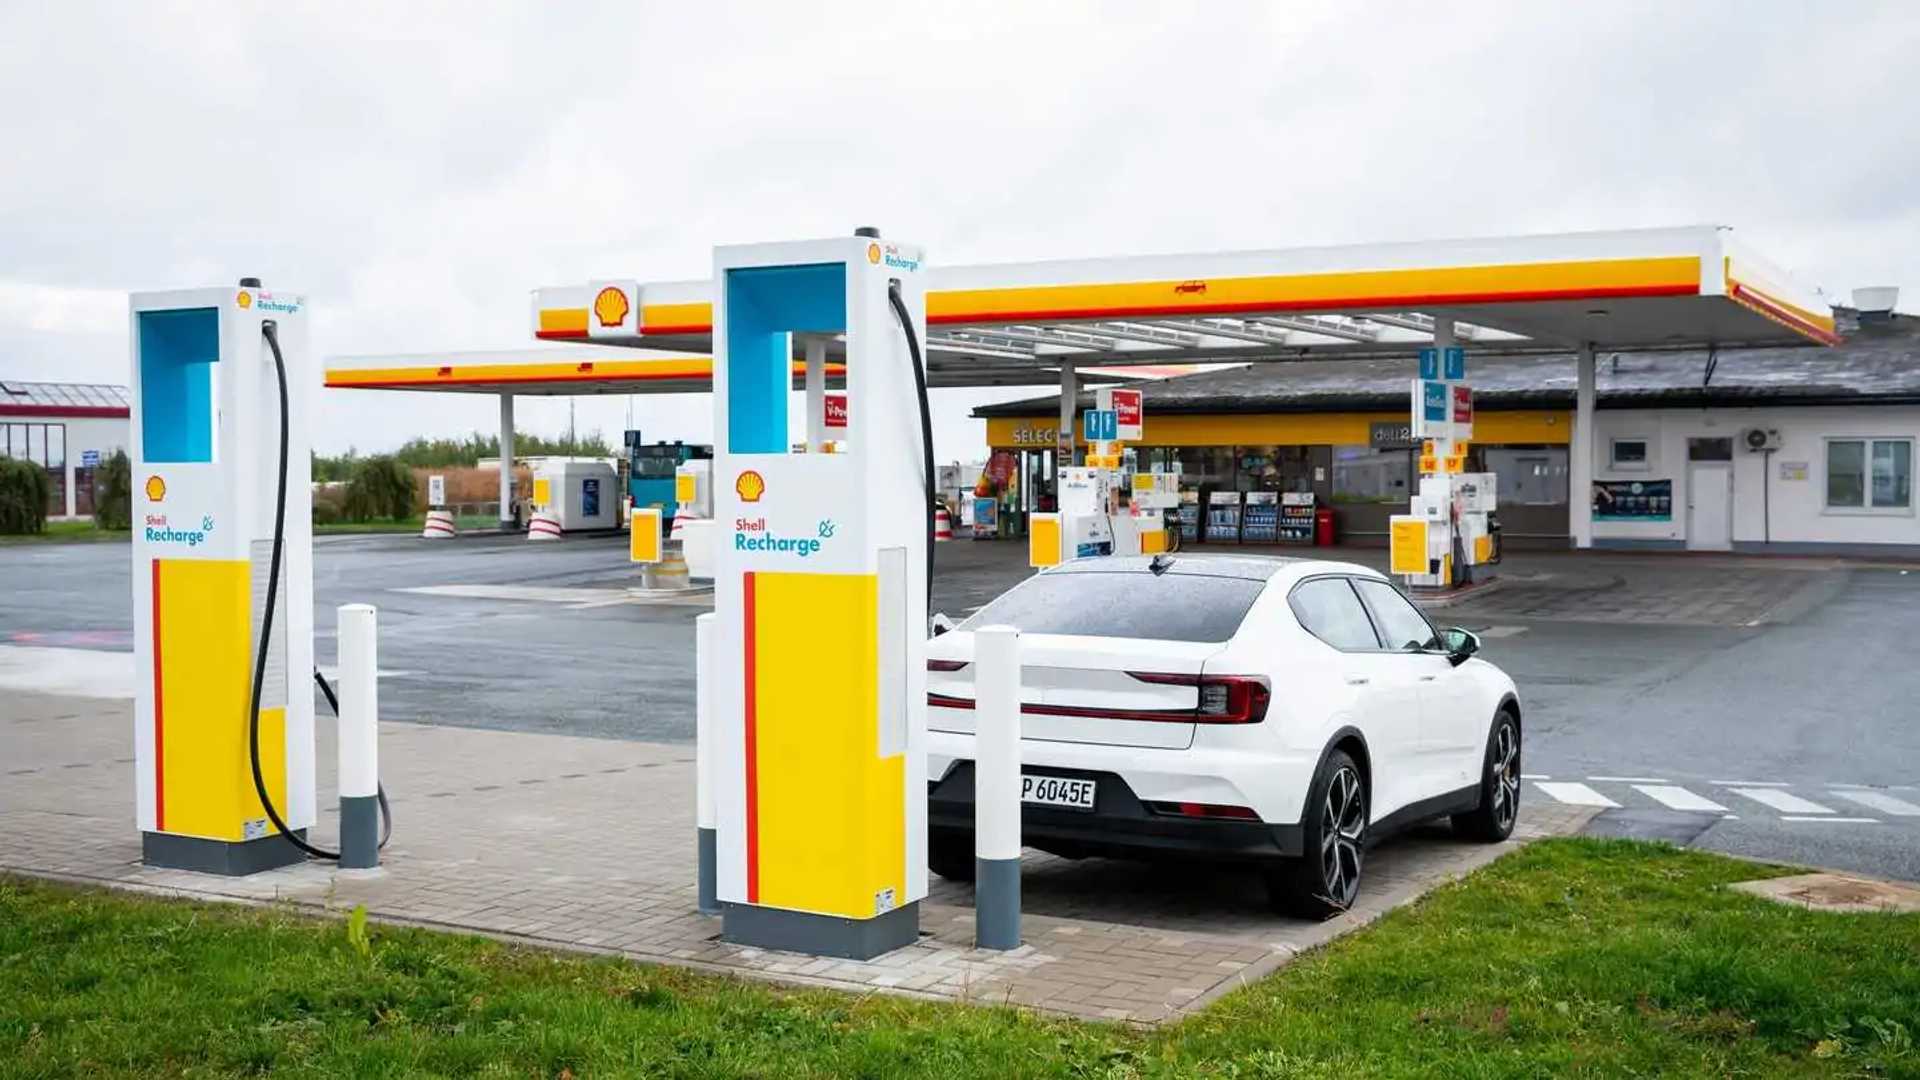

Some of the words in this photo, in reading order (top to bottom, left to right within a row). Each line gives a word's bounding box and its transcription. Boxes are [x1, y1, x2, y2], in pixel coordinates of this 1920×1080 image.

[1013, 429, 1058, 442] SELEC
[146, 515, 167, 526] Shell
[736, 518, 765, 531] Shell
[146, 526, 204, 546] Recharge
[735, 532, 820, 556] Recharge
[1036, 779, 1092, 804] 6045E
